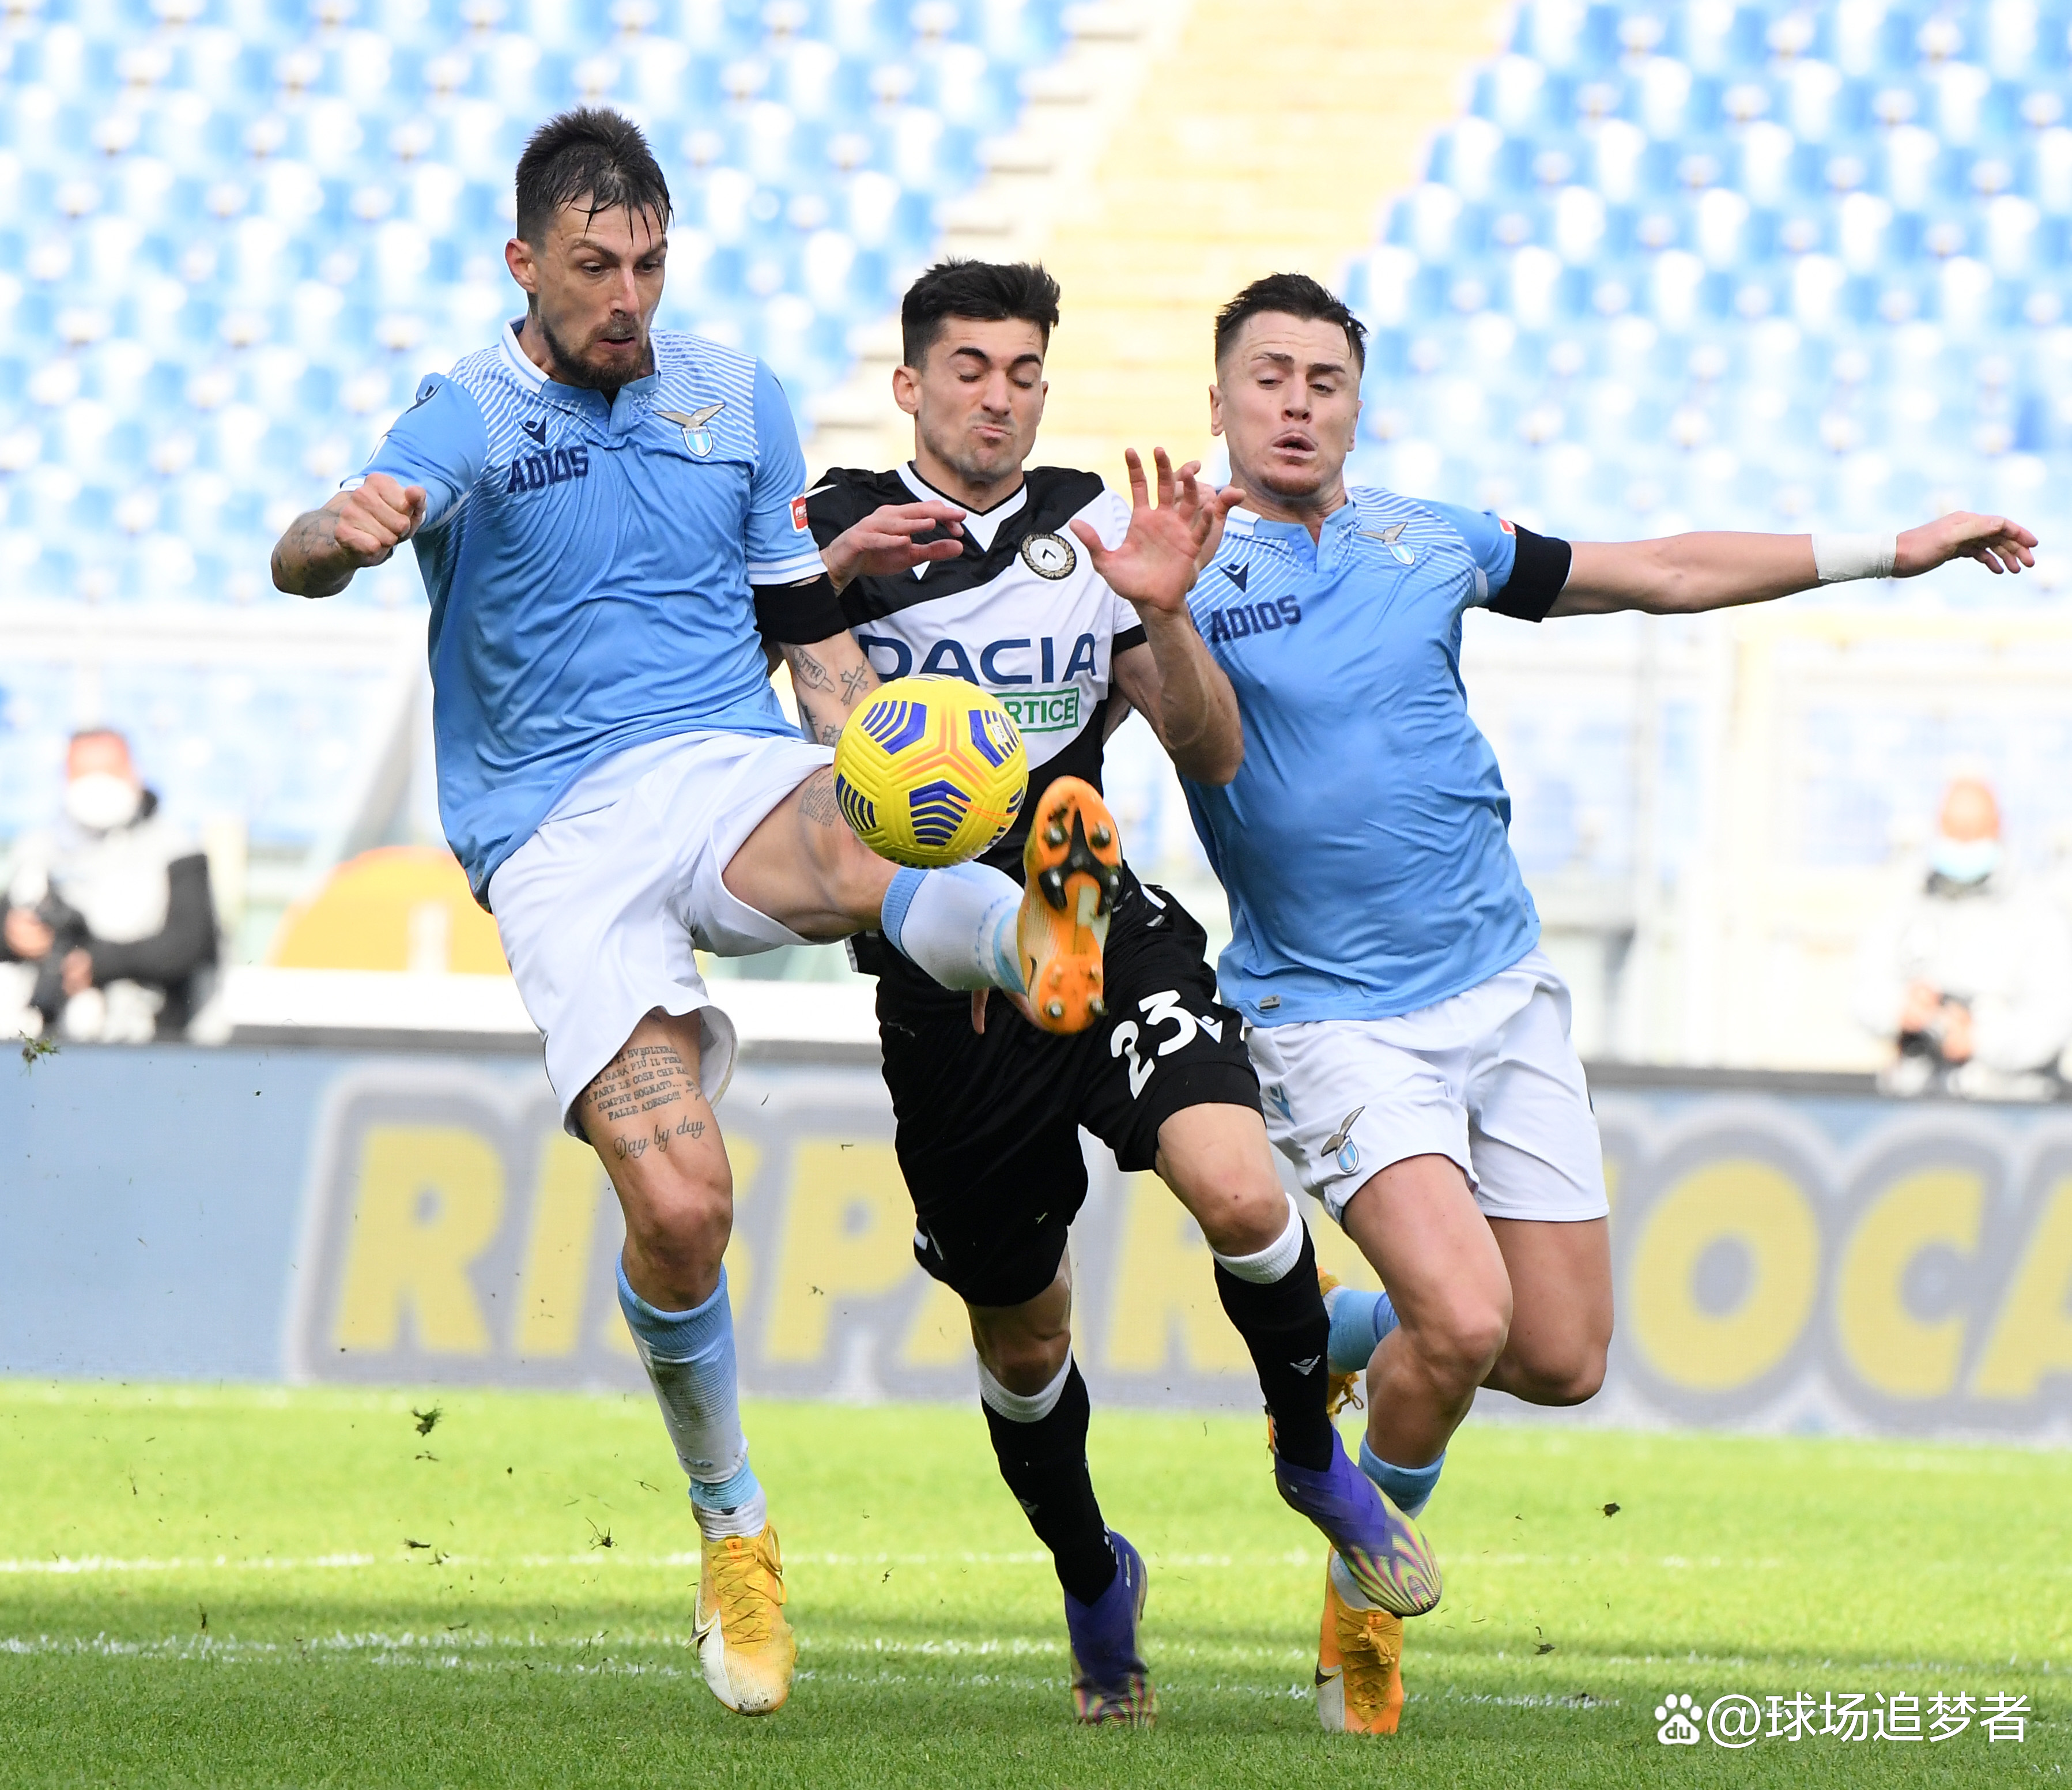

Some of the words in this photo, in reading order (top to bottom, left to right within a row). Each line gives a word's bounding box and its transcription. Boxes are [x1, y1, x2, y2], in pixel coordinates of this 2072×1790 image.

[859, 633, 1096, 686] DACIA
[1003, 697, 1075, 725] RTICE
[1111, 990, 1197, 1100] 23
[632, 1072, 655, 1084] COSE
[656, 1067, 674, 1077] CHE
[598, 1093, 632, 1113] SEMPRE
[608, 1105, 639, 1121] FALLE
[613, 1133, 650, 1160] Day
[654, 1124, 670, 1152] by
[676, 1115, 706, 1139] day
